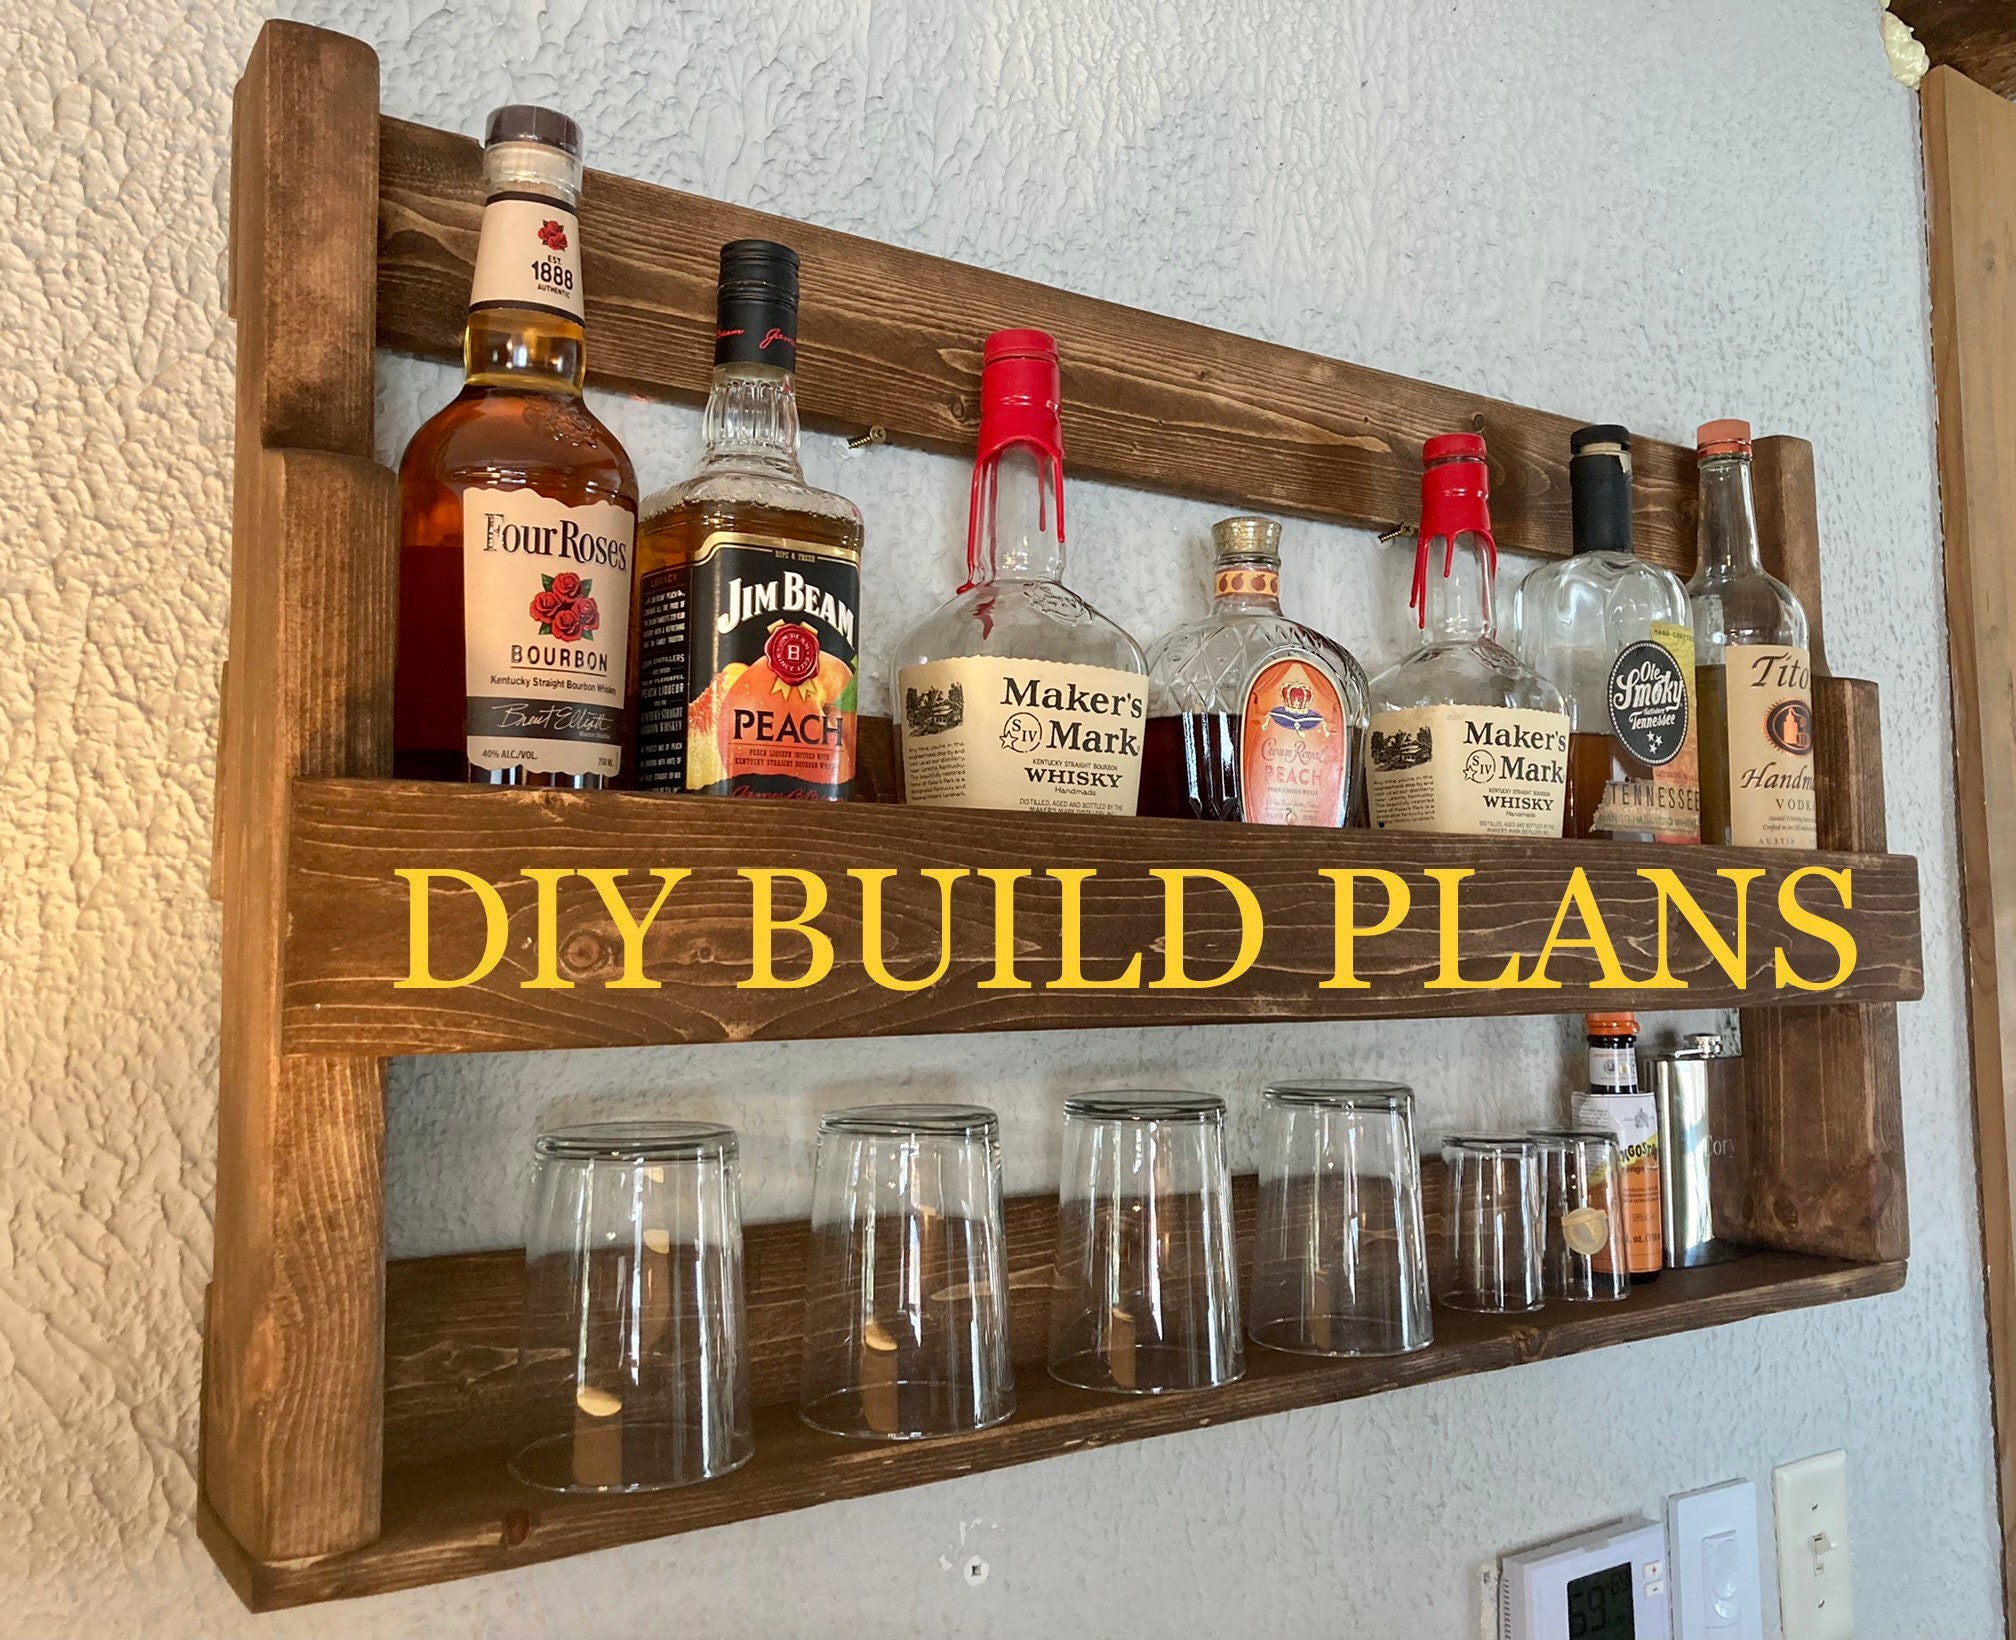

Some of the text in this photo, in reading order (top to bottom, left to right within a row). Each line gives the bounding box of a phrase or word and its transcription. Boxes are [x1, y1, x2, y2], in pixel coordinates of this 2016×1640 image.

[531, 260, 573, 290] 1888
[537, 284, 571, 299] AUTHENTIC
[483, 513, 627, 572] Four Roses
[718, 577, 778, 635] JIM
[783, 571, 855, 648] BEAM
[511, 644, 608, 672] BOURBON
[788, 644, 800, 661] B
[1641, 661, 1661, 681] Ole
[1751, 652, 1811, 690] Tito
[490, 675, 530, 688] Kentucky
[532, 677, 565, 689] Straight
[566, 680, 596, 691] Bourbon
[1613, 668, 1685, 710] Smoky
[1000, 676, 1143, 719] Maker's
[733, 709, 843, 747] PEACH
[1011, 718, 1038, 743] S IV
[1629, 711, 1676, 730] Tennessee
[1046, 720, 1140, 757] Mark
[1463, 720, 1566, 752] Maker's
[482, 749, 500, 758] 40%
[1261, 738, 1292, 761] Crown
[735, 757, 764, 765] KENTUCKY
[767, 759, 793, 767] STRAIGHT
[1033, 758, 1118, 771] KENTUCKY STRAIGHT BOURBON
[1472, 755, 1492, 775] S IV
[1499, 755, 1564, 784] Mark
[1024, 767, 1123, 788] WHISKY
[1265, 765, 1322, 786] PEACH
[1055, 786, 1097, 796] Handmade
[1609, 782, 1700, 811] TENNESSEE
[1052, 800, 1068, 808] AGED
[1082, 802, 1106, 810] BOTTLED
[1483, 795, 1554, 811] WHISKY
[1759, 837, 1795, 845] AUSTIN
